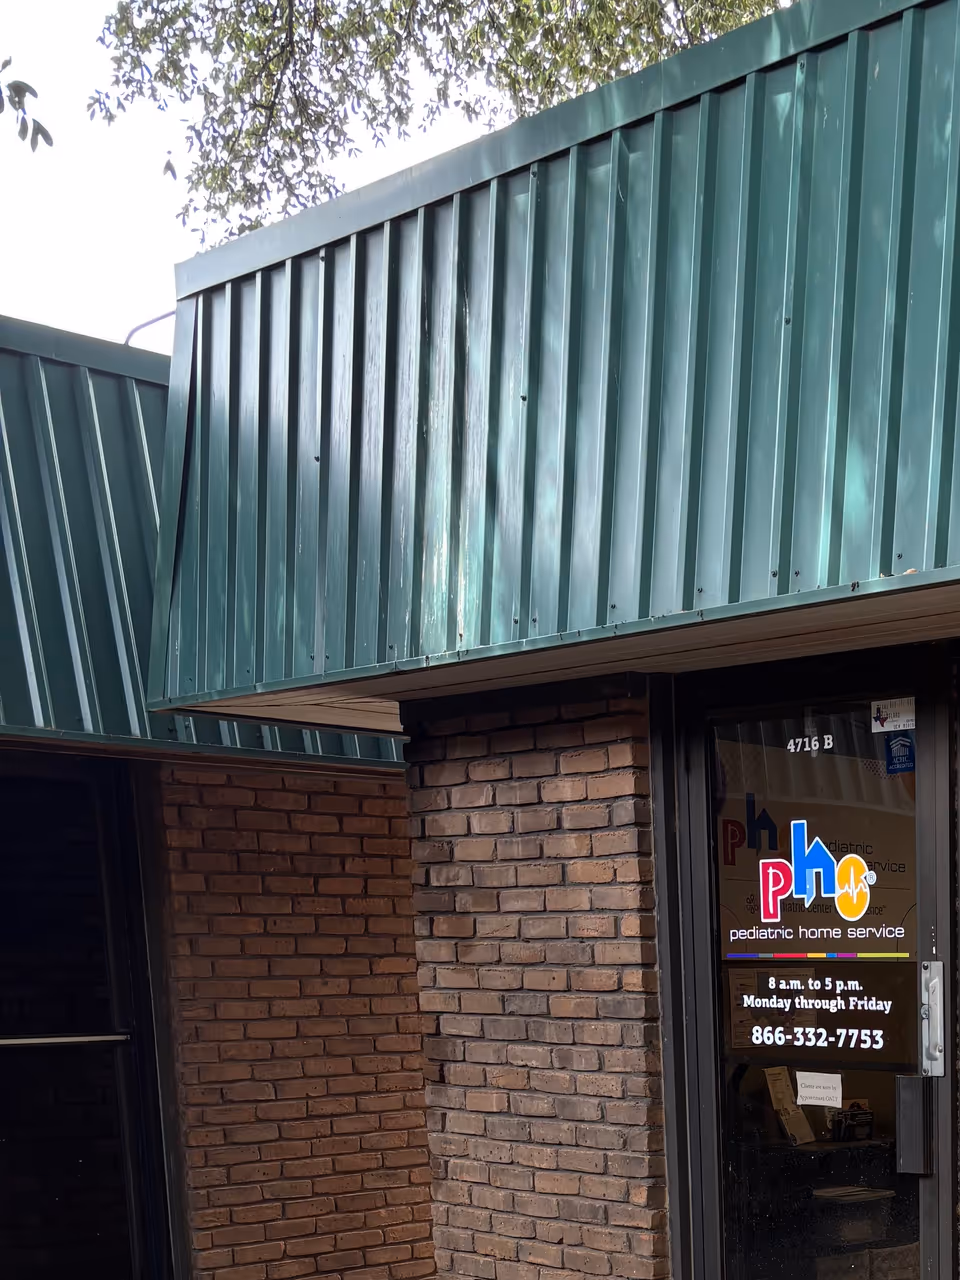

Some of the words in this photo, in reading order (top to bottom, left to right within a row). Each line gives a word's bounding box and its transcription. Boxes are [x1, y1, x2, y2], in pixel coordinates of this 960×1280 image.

[787, 737, 819, 753] 4716
[823, 735, 834, 749] B
[730, 926, 793, 942] pediatric
[799, 926, 841, 938] home
[847, 924, 904, 938] service
[768, 977, 776, 989] 8
[779, 979, 805, 990] a.m.
[808, 978, 821, 990] to
[825, 978, 832, 990] 5
[835, 979, 863, 994] p.m.
[743, 995, 791, 1011] Monday
[795, 996, 845, 1013] through
[849, 997, 892, 1014] Friday
[752, 1026, 884, 1049] 866-332-7753
